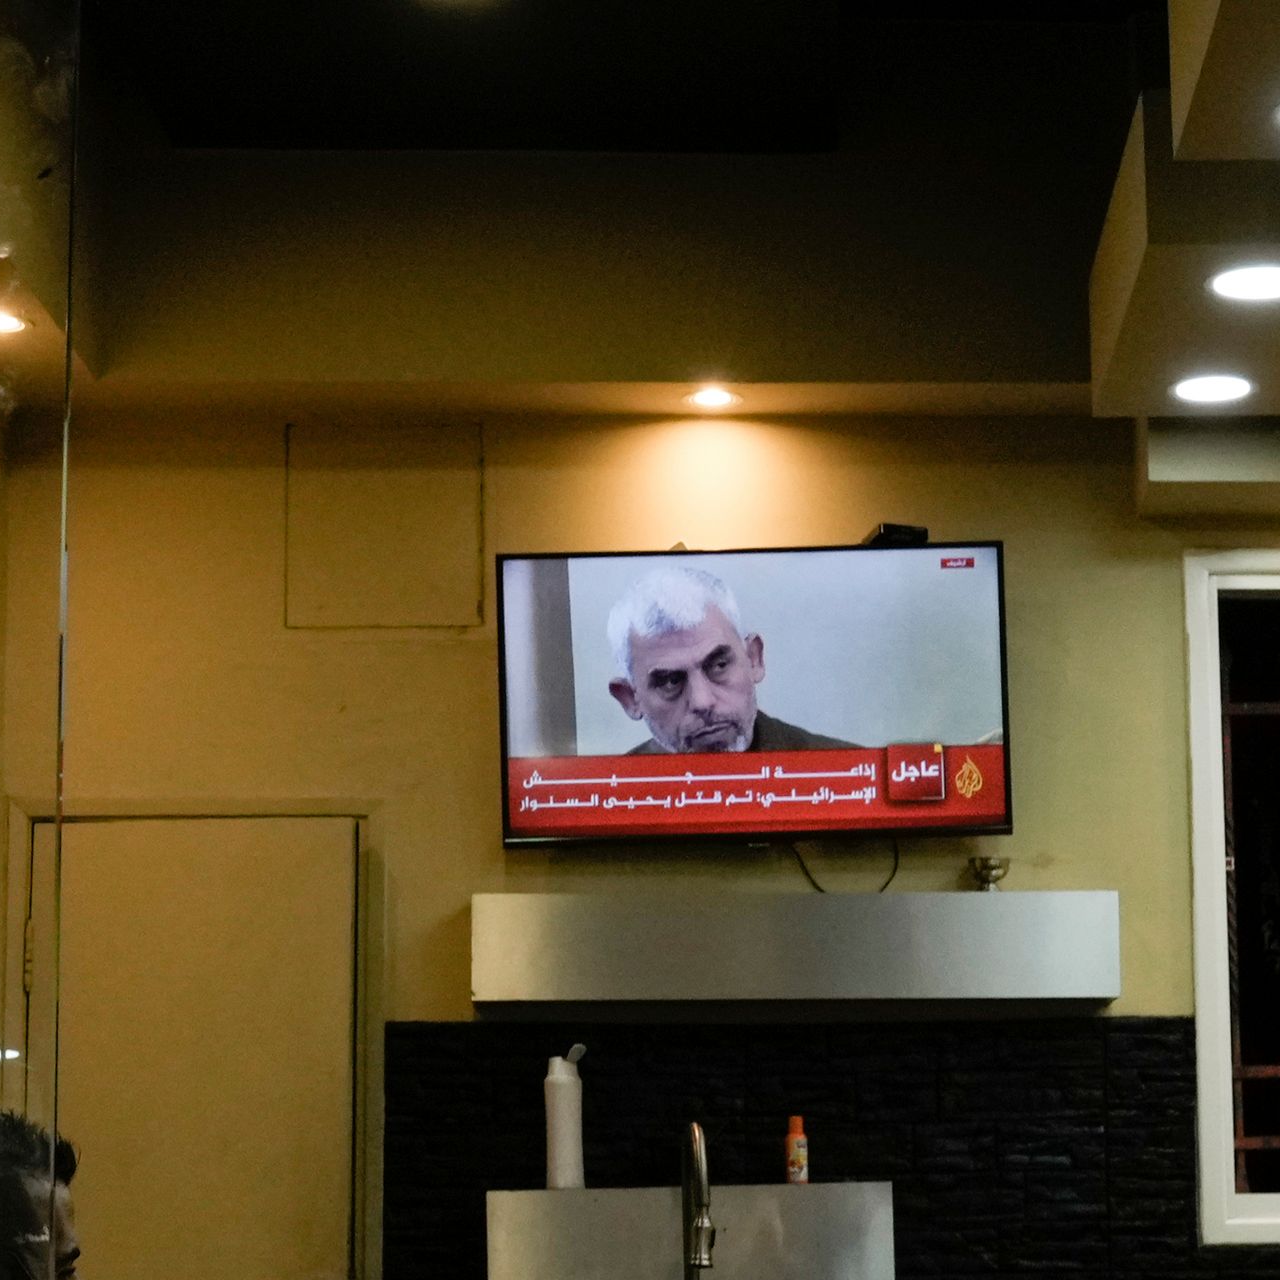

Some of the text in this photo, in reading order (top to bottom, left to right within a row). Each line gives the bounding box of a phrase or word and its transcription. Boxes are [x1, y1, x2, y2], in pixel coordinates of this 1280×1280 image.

[523, 763, 877, 789] إذاعة الجيش
[892, 761, 940, 783] عاجل
[519, 794, 599, 812] السنوار
[602, 794, 672, 811] يحيى
[674, 790, 722, 808] قتل
[725, 790, 753, 807] تم
